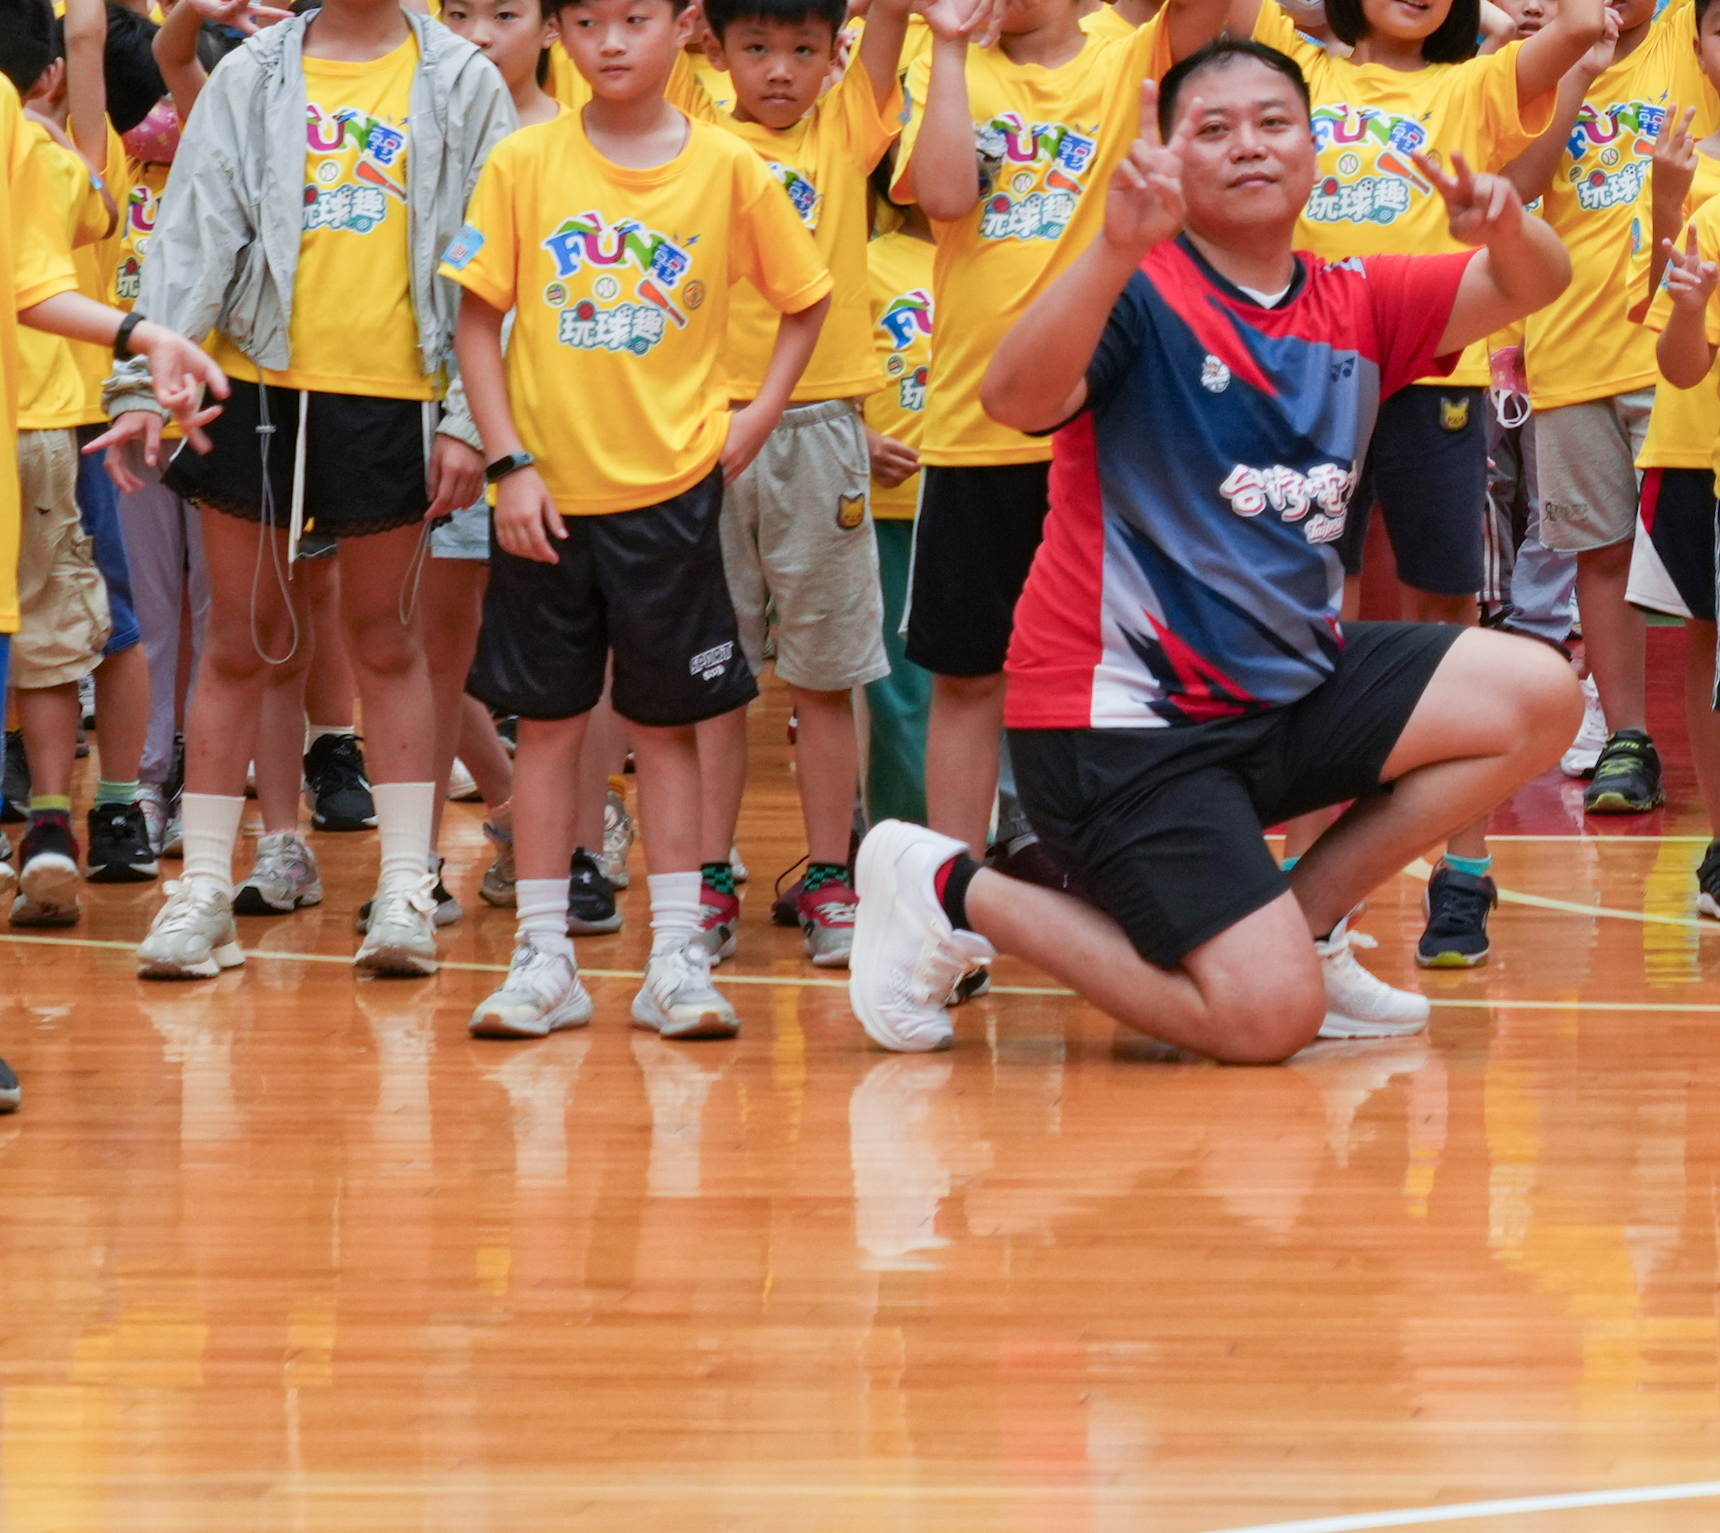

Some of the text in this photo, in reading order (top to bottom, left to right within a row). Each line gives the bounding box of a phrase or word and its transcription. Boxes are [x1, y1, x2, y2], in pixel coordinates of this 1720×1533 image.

[1307, 176, 1410, 223] 玩球趣
[541, 211, 693, 288] FUN電
[558, 302, 665, 356] 玩球趣
